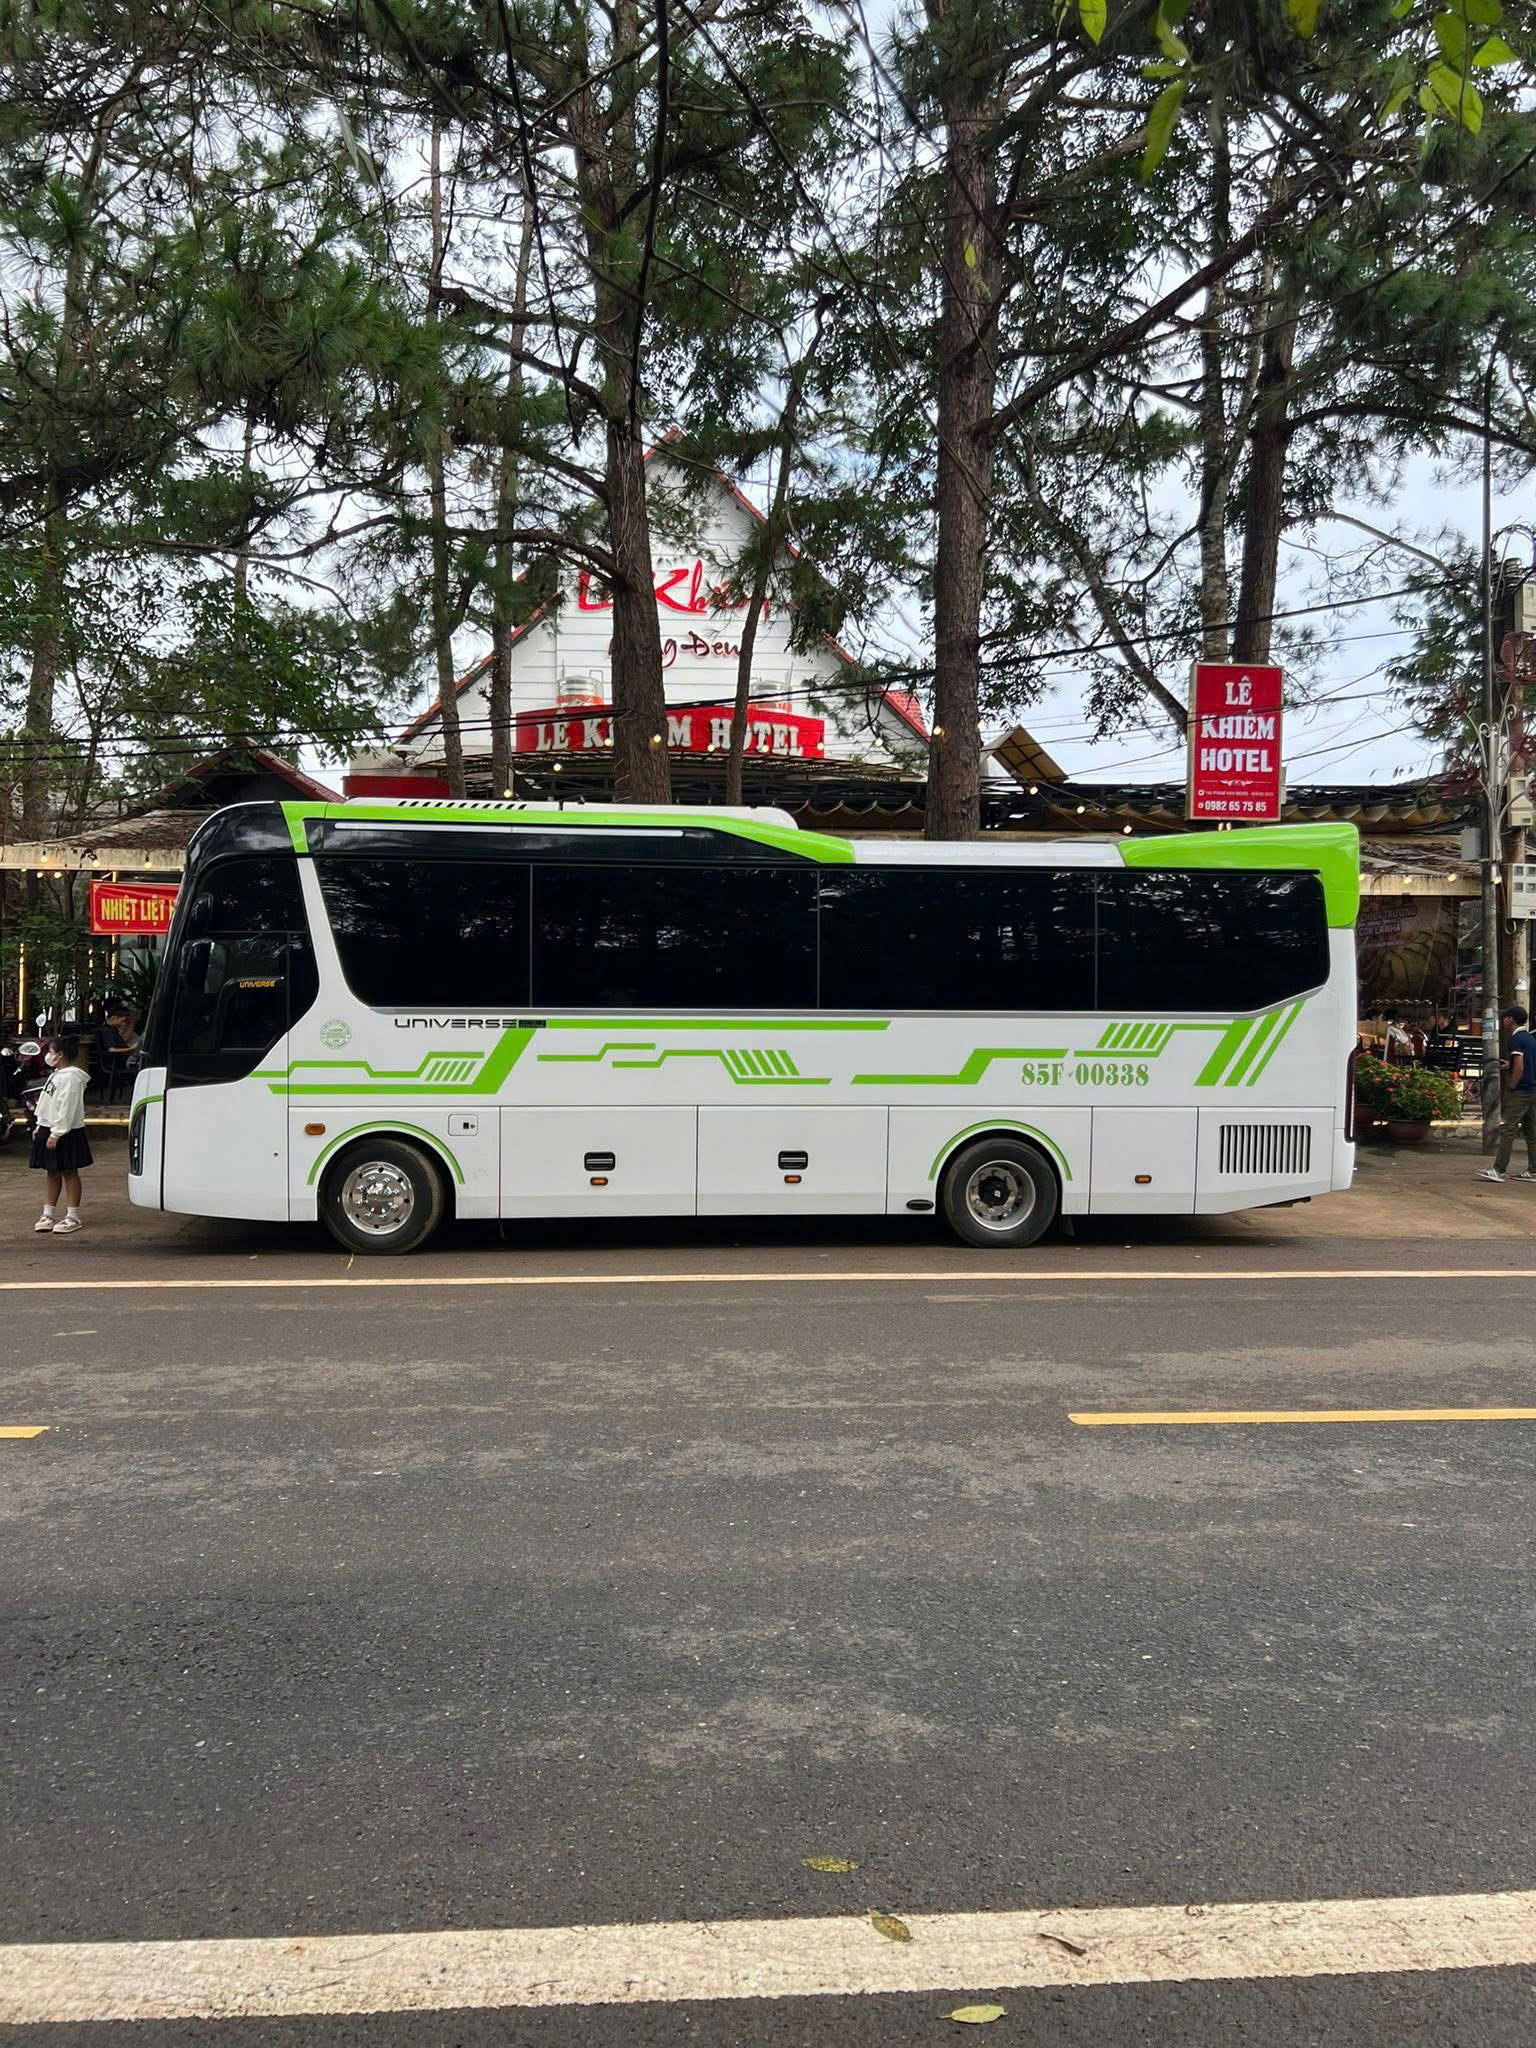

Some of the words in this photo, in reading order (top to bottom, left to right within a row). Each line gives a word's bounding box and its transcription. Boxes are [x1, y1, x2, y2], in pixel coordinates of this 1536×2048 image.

[1225, 675, 1253, 705] LÊ
[536, 707, 569, 751] LÊ
[1200, 709, 1275, 740] KHIÊM
[1200, 748, 1273, 772] HOTEL
[1205, 801, 1227, 811] 0982
[1229, 801, 1240, 811] 65
[1242, 801, 1254, 812] 75
[1255, 802, 1267, 812] 85
[101, 894, 137, 926] NHIỆT
[141, 894, 165, 926] LIỆT
[395, 1018, 517, 1028] UNIVERSE
